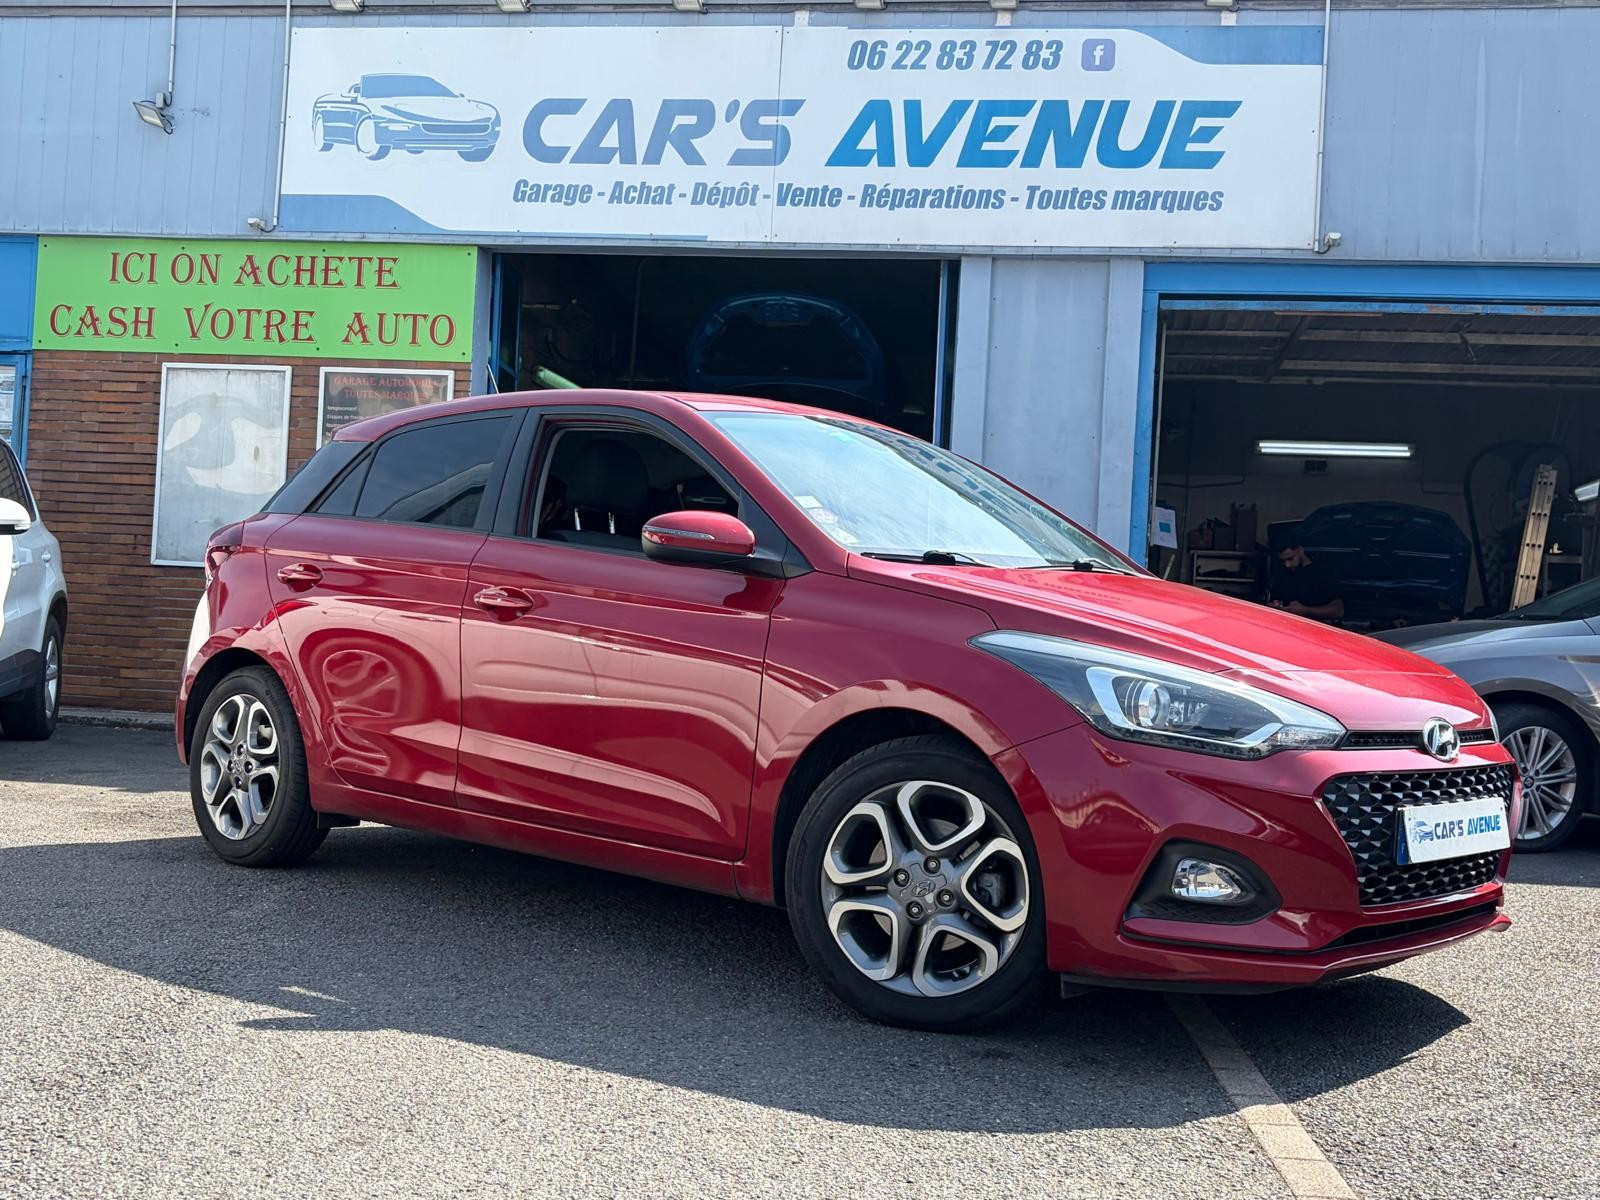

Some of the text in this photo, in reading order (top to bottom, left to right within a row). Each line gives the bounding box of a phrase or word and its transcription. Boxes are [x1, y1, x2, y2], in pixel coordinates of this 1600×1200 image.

[847, 40, 1064, 71] 06 22 83 72 83
[522, 98, 1242, 169] CAR'S AVENUE
[512, 178, 594, 206] Garage
[608, 180, 676, 205] Achat
[690, 181, 760, 208] Dépôt
[776, 183, 844, 208] Vente
[859, 183, 1005, 211] Réparations
[1025, 185, 1107, 210] Toutes
[1110, 190, 1224, 213] marques
[108, 252, 400, 288] ICI ON ACHETE
[50, 302, 456, 347] CASH VOTRE AUTO
[334, 376, 376, 386] GARAGE
[343, 389, 380, 399] TOUTES
[1434, 814, 1501, 840] CAR'S AVENUE
